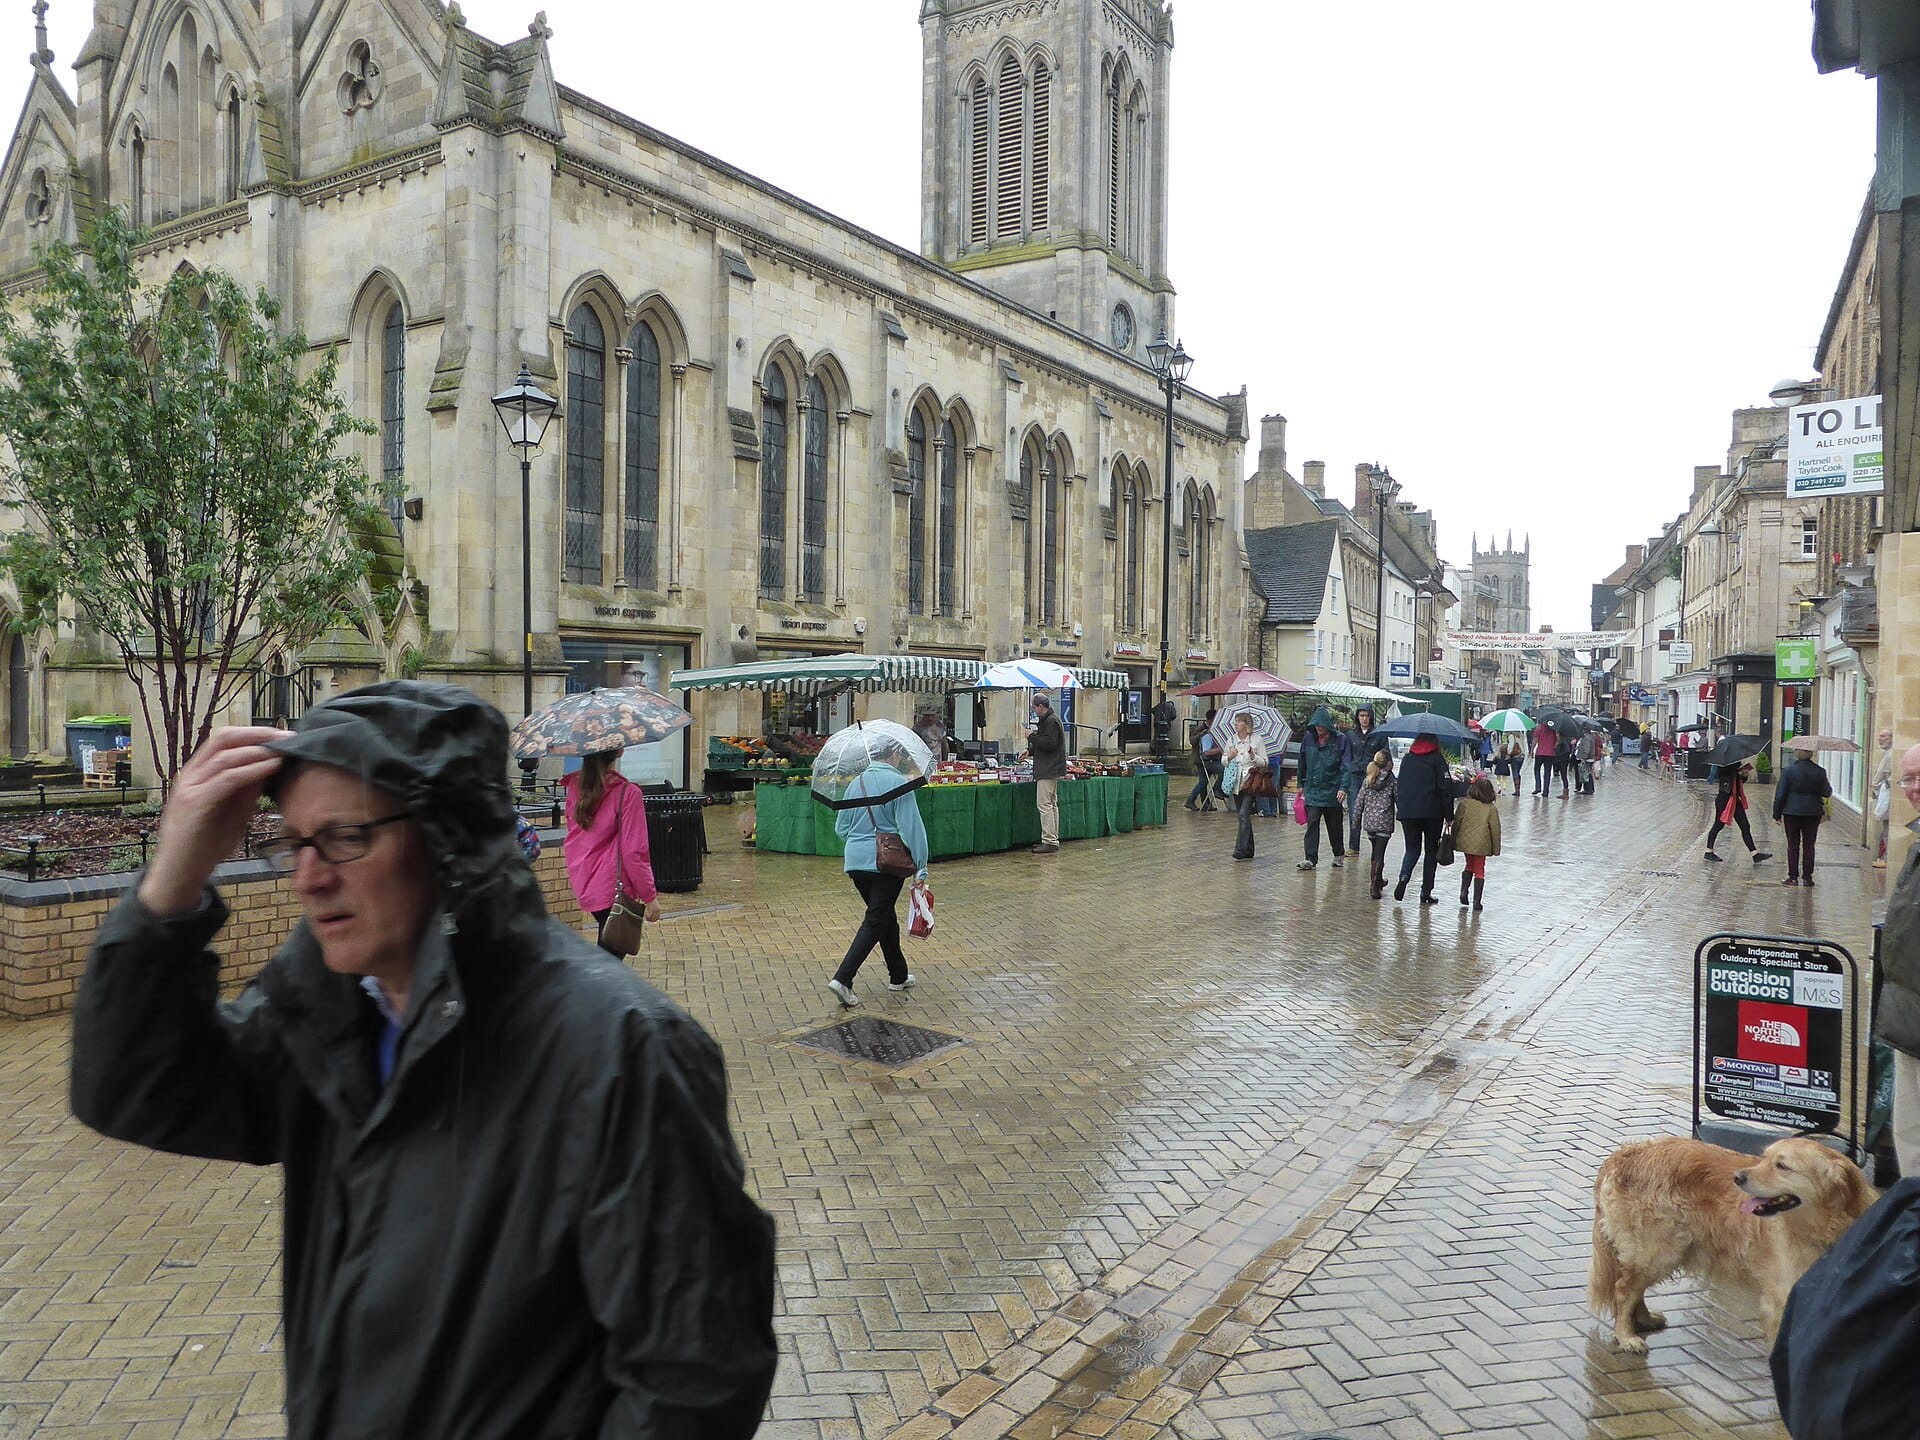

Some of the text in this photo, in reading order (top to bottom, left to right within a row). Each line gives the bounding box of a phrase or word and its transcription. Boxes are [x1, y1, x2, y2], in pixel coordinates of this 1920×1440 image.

[1796, 409, 1842, 436] TO
[1816, 440, 1834, 448] ALL
[1798, 456, 1831, 467] Hartnell
[1798, 464, 1844, 476] Taylor Cook
[594, 606, 657, 620] vision express
[781, 618, 828, 632] vision express
[1748, 948, 1798, 959] Independant
[1720, 954, 1828, 971] Outdoors Specialist Store
[1711, 968, 1791, 987] precision
[1710, 980, 1790, 1000] outdoors
[1803, 987, 1840, 1004] M&S
[1744, 1024, 1781, 1036] NORTH
[1760, 1019, 1782, 1029] THE
[1754, 1034, 1782, 1044] FACE
[1726, 1060, 1775, 1074] MONTANE
[1756, 1107, 1786, 1117] Outdoor
[1764, 1114, 1794, 1125] National
